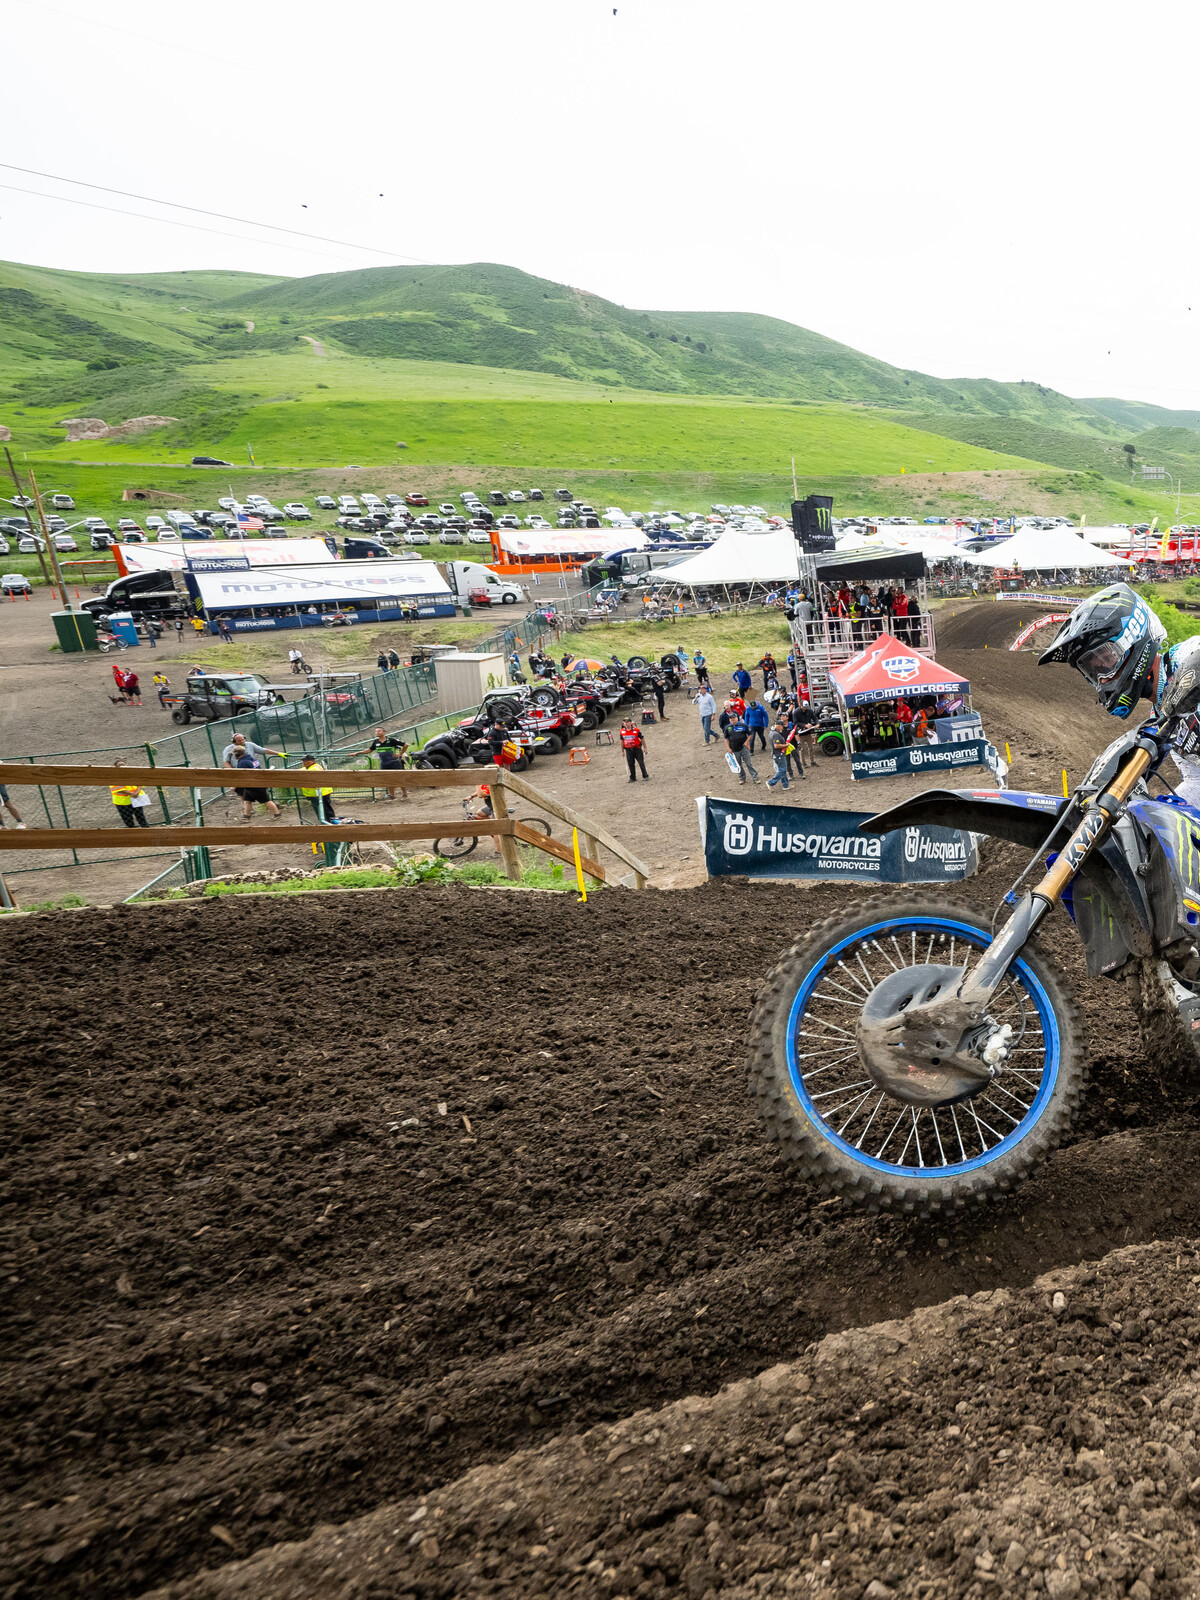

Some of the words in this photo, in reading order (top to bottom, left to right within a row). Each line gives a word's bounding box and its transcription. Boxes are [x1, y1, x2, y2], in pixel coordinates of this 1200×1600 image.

[221, 576, 426, 594] MOTOCROSS
[1131, 642, 1151, 680] MONSTER
[1183, 731, 1199, 753] THOR
[924, 748, 978, 763] Husqvarna
[1034, 798, 1057, 806] YAMAHA
[757, 826, 882, 858] Husqvarna
[1065, 815, 1104, 872] KYB
[818, 860, 880, 871] MOTORCYCLES
